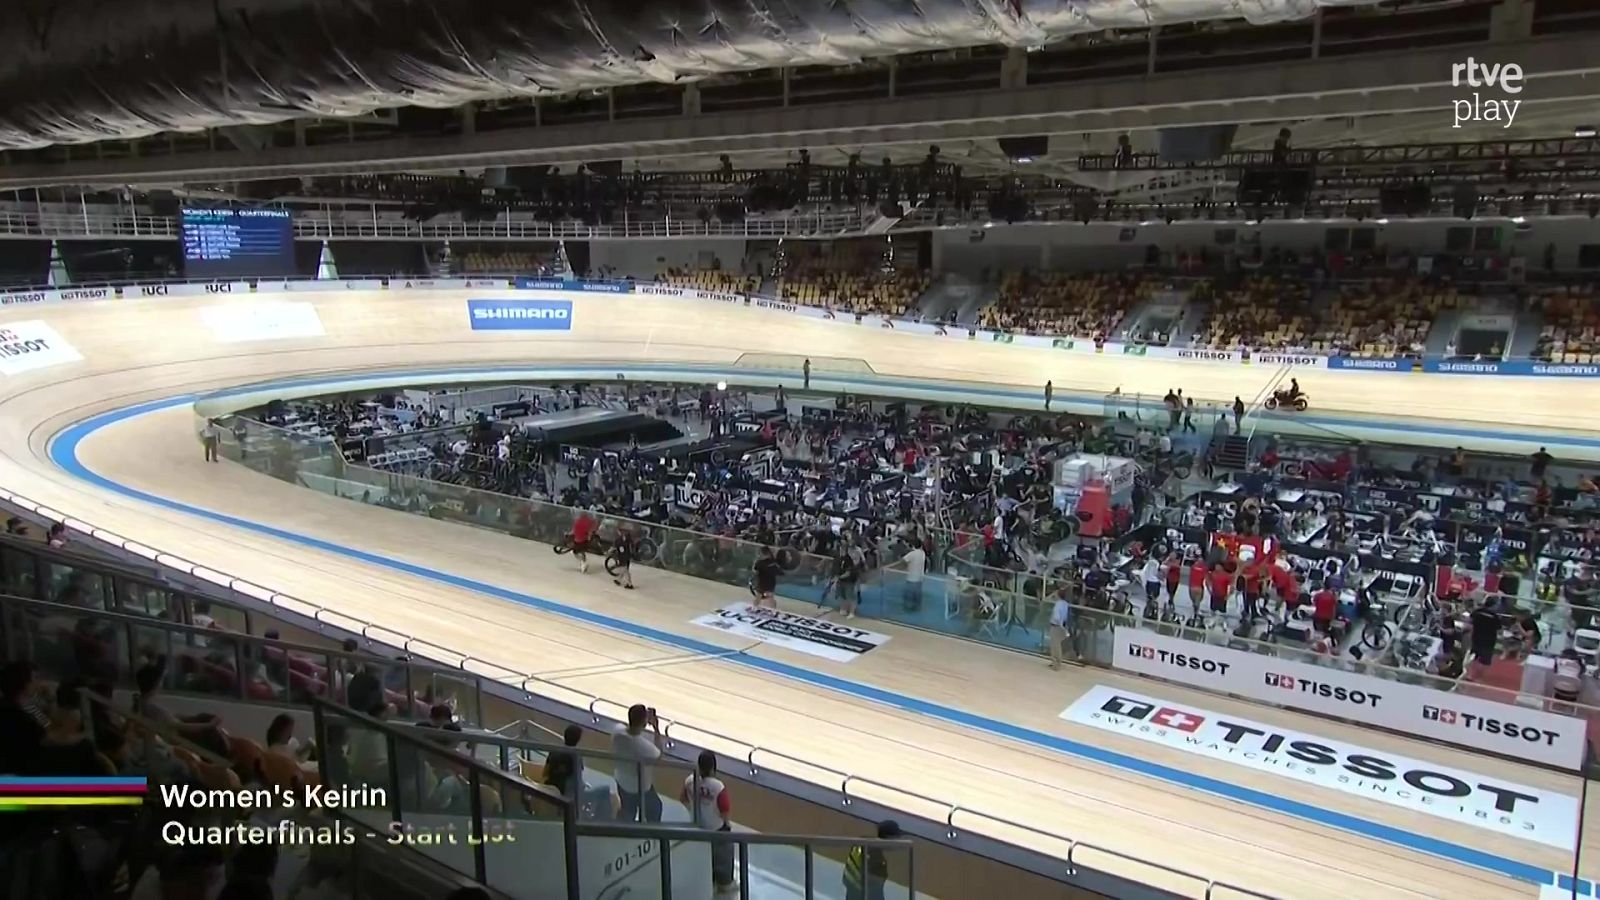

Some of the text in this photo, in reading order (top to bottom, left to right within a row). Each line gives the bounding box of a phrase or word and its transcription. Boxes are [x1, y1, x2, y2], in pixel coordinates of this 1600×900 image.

[14, 293, 46, 302] TISSOT
[75, 290, 107, 299] TISSOT
[707, 293, 737, 302] TISSOT
[474, 308, 568, 319] SHIMANO
[1193, 351, 1232, 360] TISSOT
[1276, 356, 1317, 365] TISSOT
[1343, 359, 1397, 369] SHIMANO
[782, 612, 870, 638] TISSOT
[1157, 650, 1230, 675] TISSOT
[1298, 679, 1382, 707] TISSOT
[1461, 713, 1560, 745] TISSOT
[1090, 712, 1166, 737] SWISS
[1186, 736, 1316, 775] WATCHES
[1337, 774, 1433, 805] SINCE
[1216, 721, 1539, 813] TISSOT
